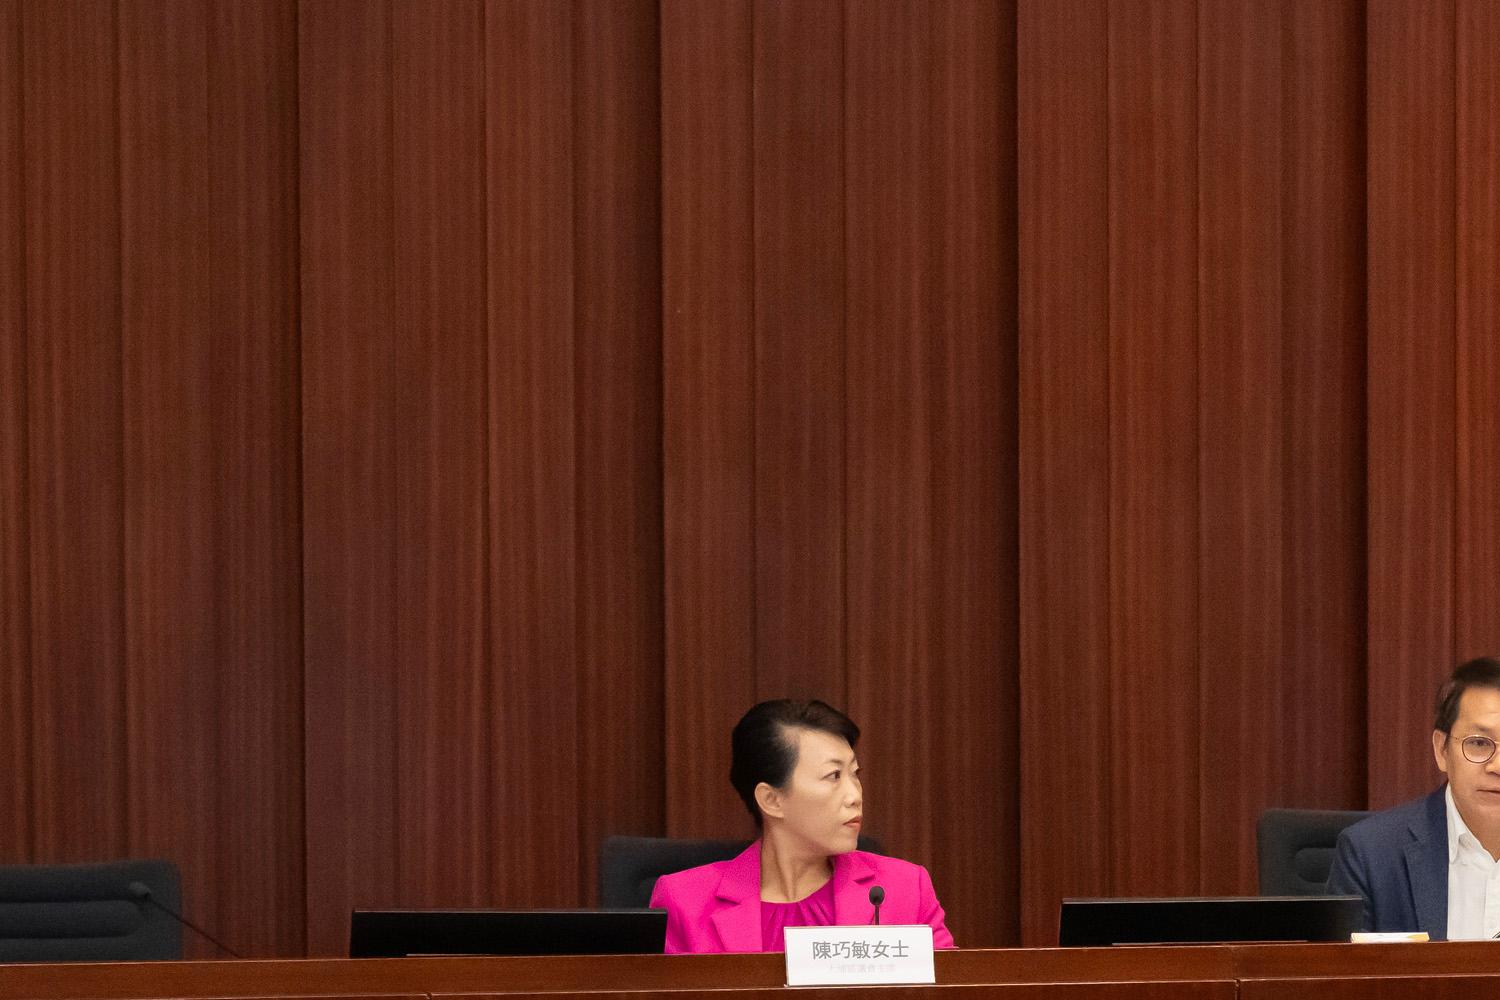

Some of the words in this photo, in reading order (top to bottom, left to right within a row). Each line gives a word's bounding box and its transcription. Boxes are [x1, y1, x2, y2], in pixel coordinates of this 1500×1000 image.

[812, 939, 910, 959] 陳巧敏女士
